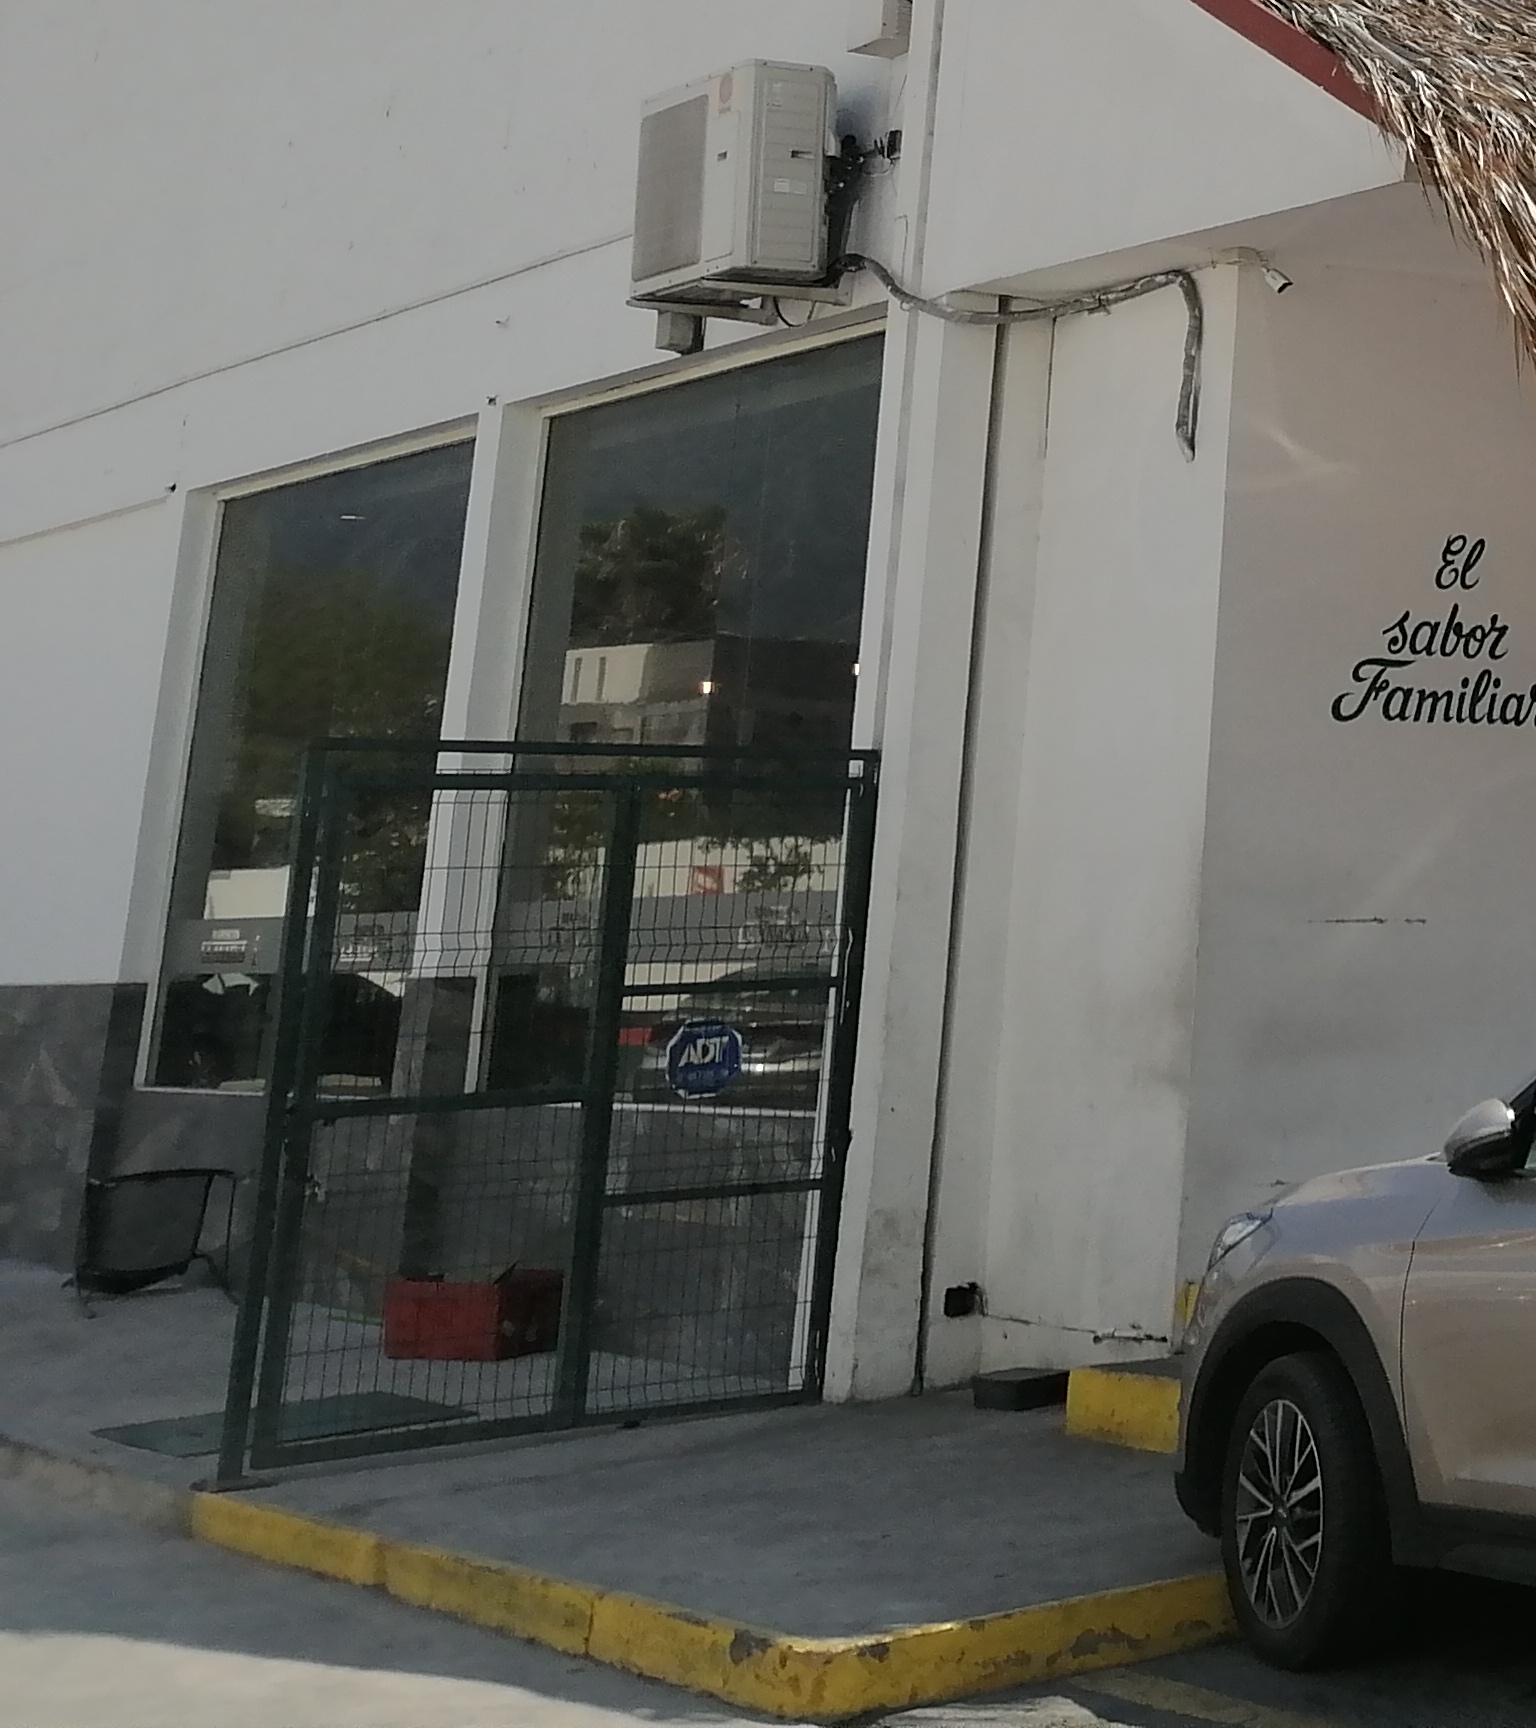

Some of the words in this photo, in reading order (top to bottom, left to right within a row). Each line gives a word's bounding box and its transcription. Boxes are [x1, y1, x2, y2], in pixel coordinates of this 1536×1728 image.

[1435, 534, 1486, 590] El
[1382, 603, 1509, 660] sabor
[678, 1035, 730, 1068] ADT
